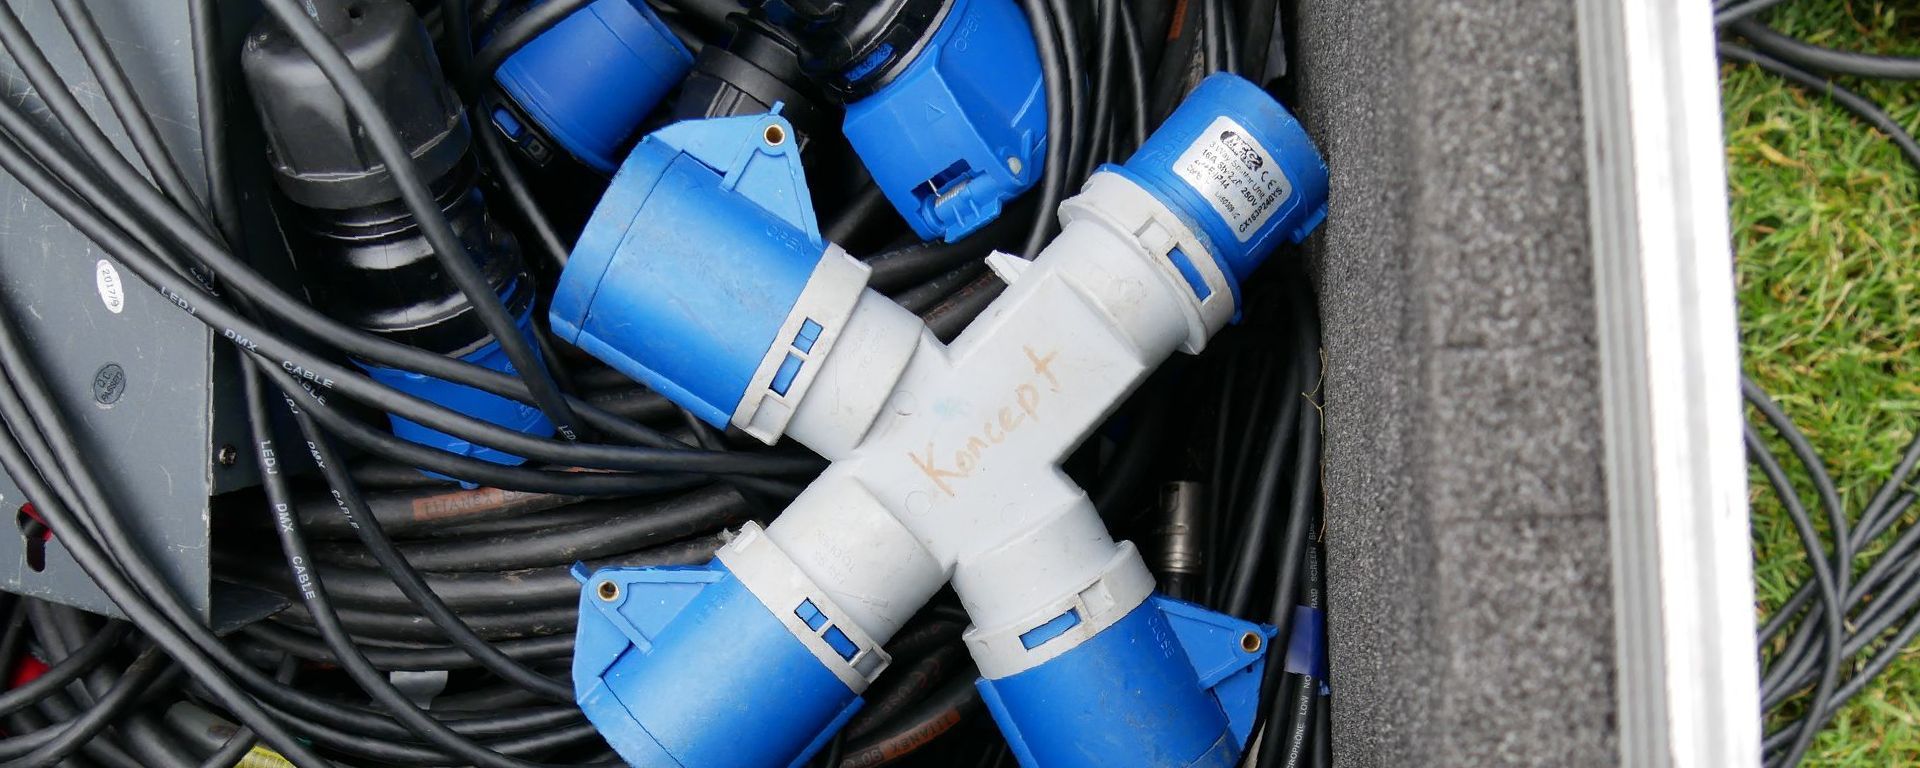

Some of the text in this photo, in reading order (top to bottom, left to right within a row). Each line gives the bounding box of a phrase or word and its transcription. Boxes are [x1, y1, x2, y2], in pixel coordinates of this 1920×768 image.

[1239, 185, 1259, 207] 250V
[102, 268, 118, 307] 2017/9
[161, 286, 334, 389] LEDJ DMX CABLE
[908, 343, 1063, 497] Koncept
[307, 440, 327, 471] DMX
[261, 440, 316, 600] LEDJ DMX CABLE
[1300, 695, 1309, 715] LOW
